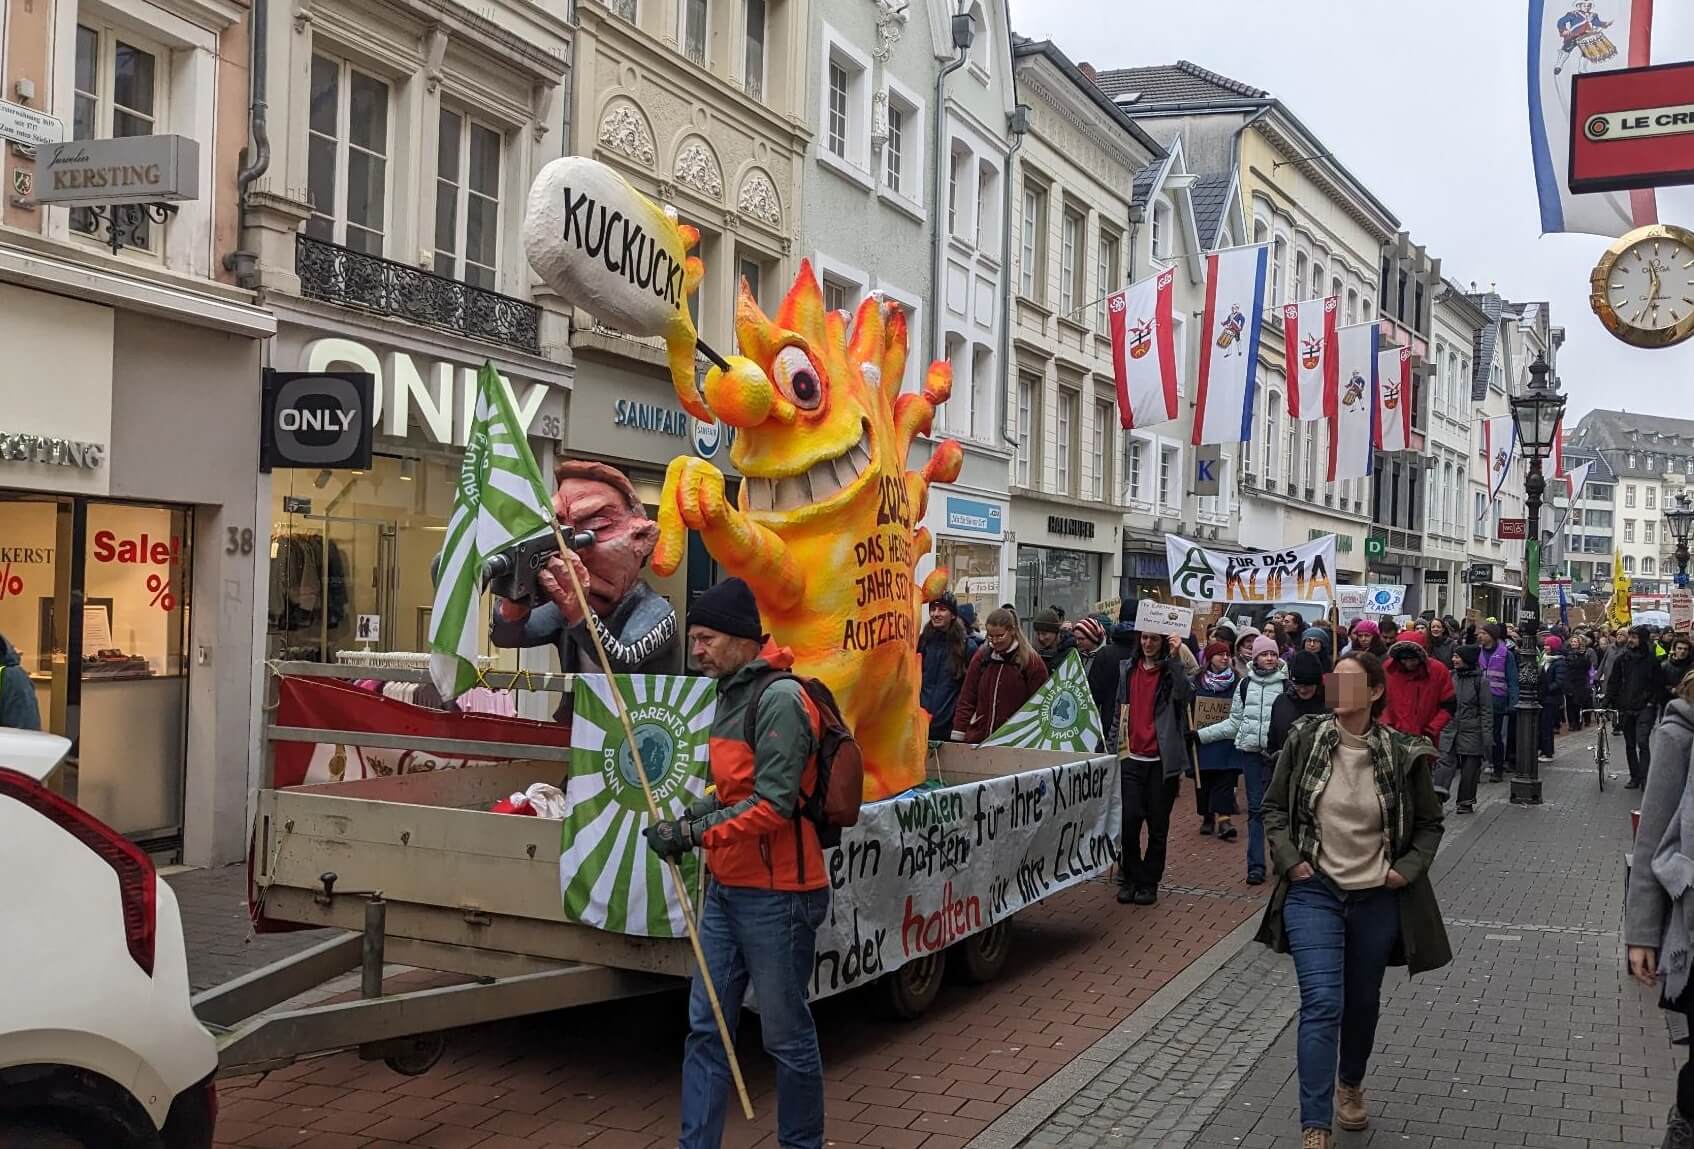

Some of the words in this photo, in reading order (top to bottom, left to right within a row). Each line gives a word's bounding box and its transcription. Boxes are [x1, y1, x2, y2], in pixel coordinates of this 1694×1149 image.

[1621, 116, 1650, 130] LE
[54, 163, 160, 190] KERSTING
[563, 187, 684, 310] KUCKUCK!
[1642, 265, 1670, 274] OEGA
[278, 409, 357, 431] ONLY
[542, 415, 560, 437] 36
[614, 399, 687, 437] SANIFAIR
[1199, 459, 1214, 480] K
[94, 530, 181, 565] Sale!
[225, 527, 253, 555] 38
[855, 534, 885, 567] DAS
[1369, 542, 1380, 553] D
[1227, 556, 1255, 568] FÜR
[1263, 551, 1298, 566] DAS
[856, 568, 894, 607] JAHR
[1226, 555, 1334, 600] KLIMA
[1367, 600, 1395, 611] PLANET
[630, 707, 685, 737] PARENTS
[677, 740, 688, 749] 4
[604, 748, 624, 795] BONN
[650, 753, 689, 803] FUTURE
[974, 784, 1004, 846] für
[1011, 776, 1042, 829] ihre
[1052, 762, 1108, 816] Kinder
[902, 880, 981, 957] haften
[1017, 851, 1049, 903] ihre
